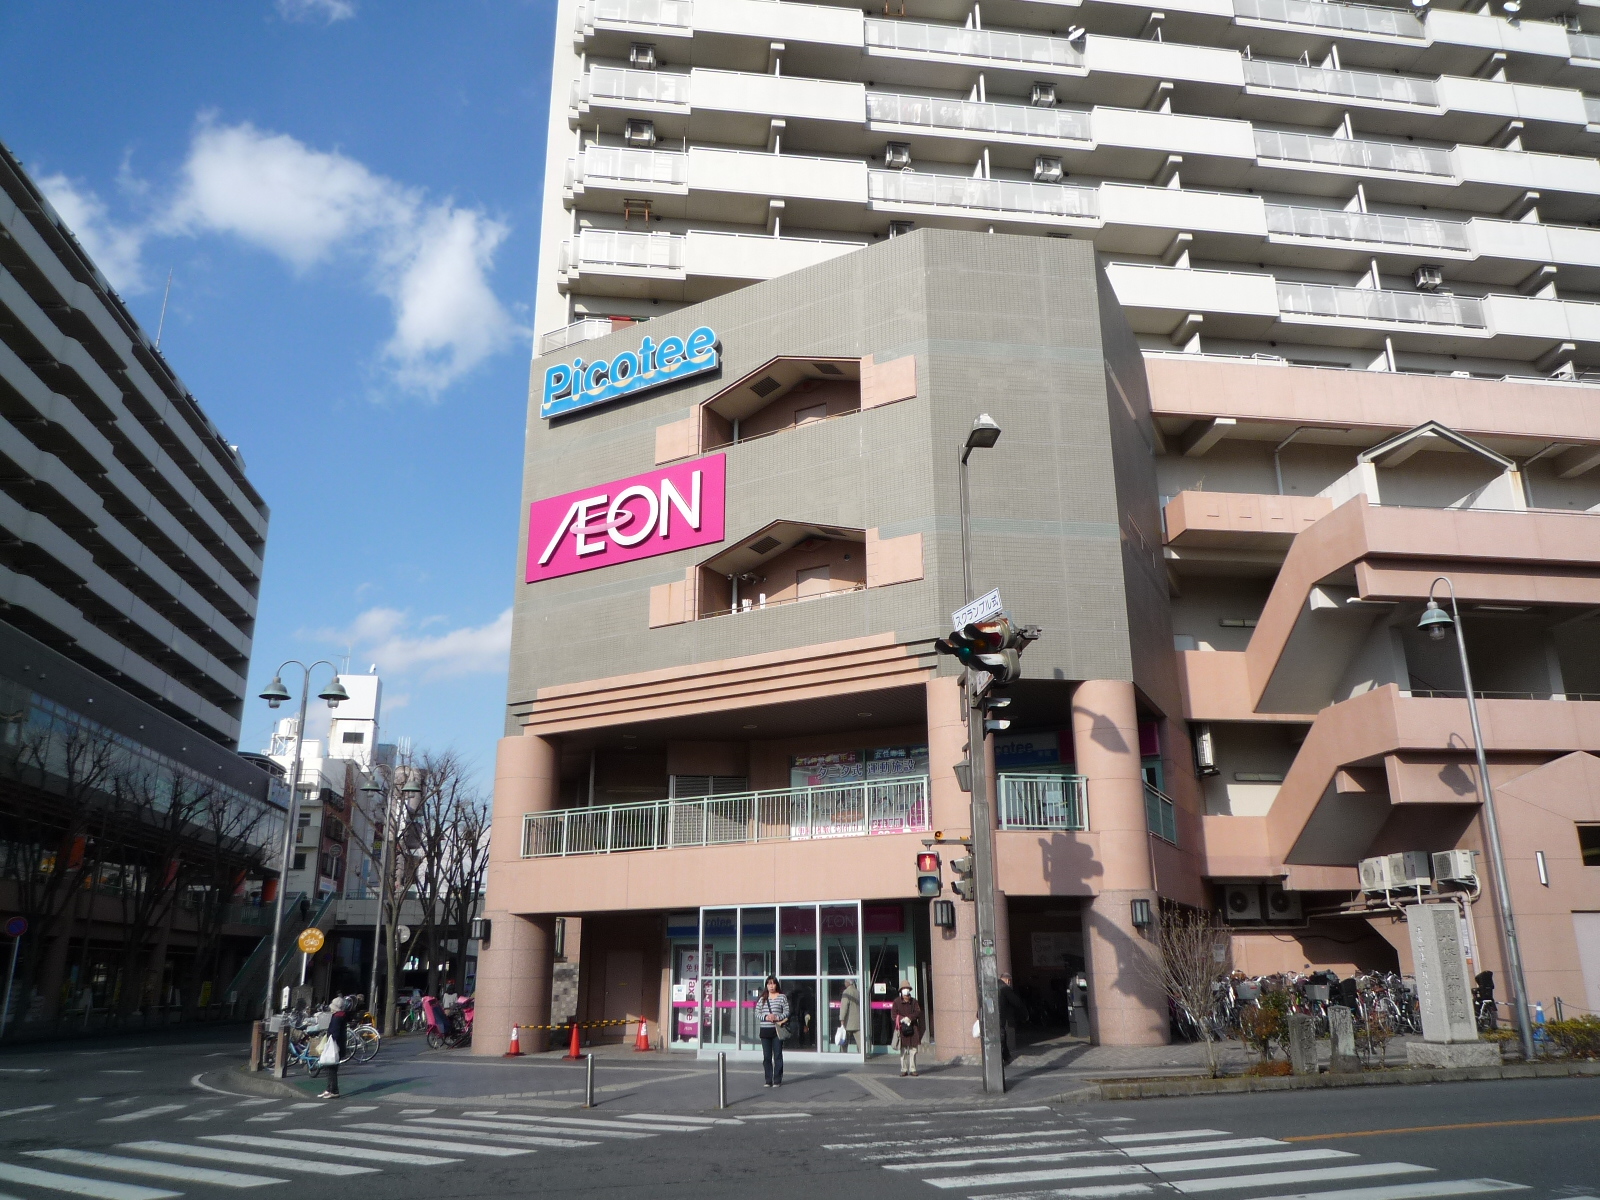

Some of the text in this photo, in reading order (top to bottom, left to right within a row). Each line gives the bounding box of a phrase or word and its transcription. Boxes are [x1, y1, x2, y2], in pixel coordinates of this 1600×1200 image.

[543, 326, 717, 409] Picotee
[955, 594, 999, 628] スクランブル式
[995, 740, 1034, 755] cotee
[817, 763, 863, 780] タニタ式
[867, 759, 916, 775] 運動施設
